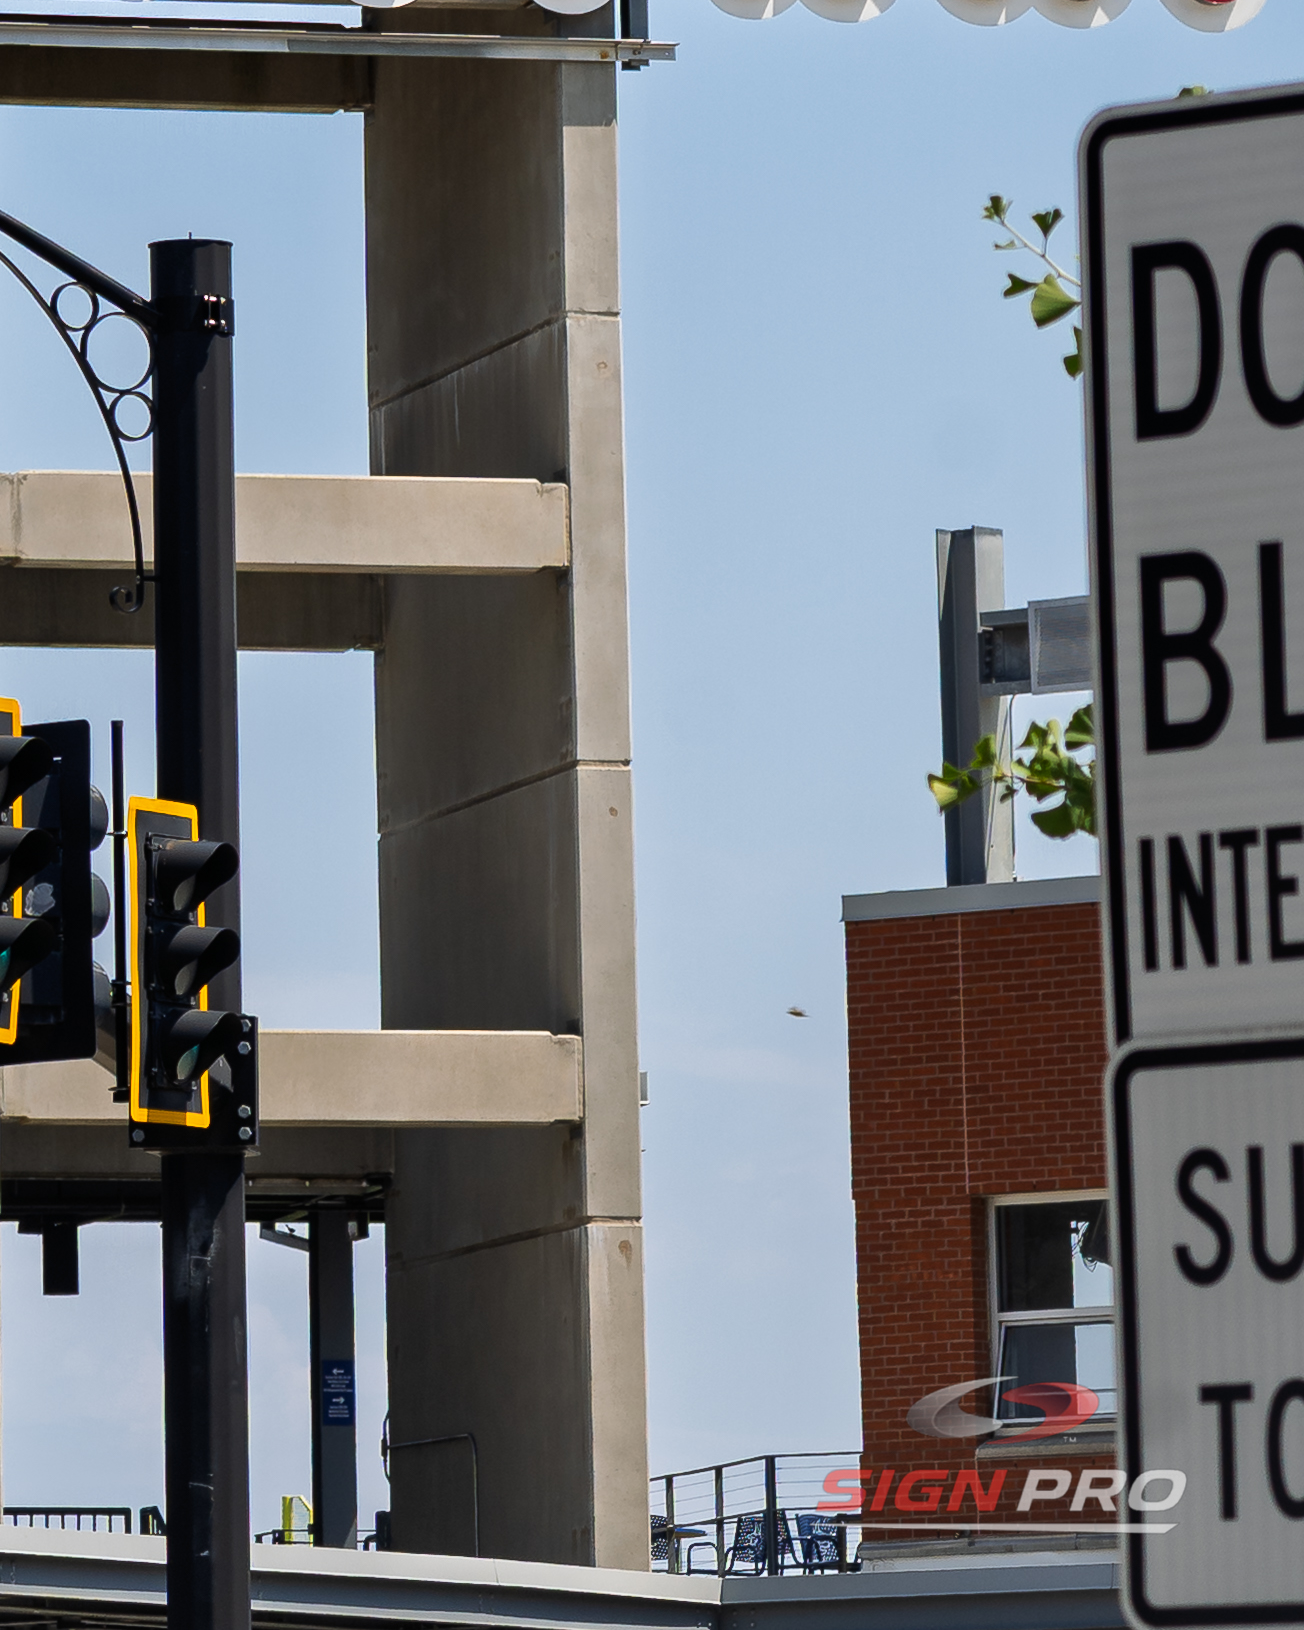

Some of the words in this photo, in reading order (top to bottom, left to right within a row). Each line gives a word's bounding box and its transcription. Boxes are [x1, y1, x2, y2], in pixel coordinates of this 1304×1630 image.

[1130, 223, 1304, 443] DO
[1140, 540, 1304, 754] BL
[1139, 825, 1304, 972] INTE
[1174, 1142, 1304, 1286] SU
